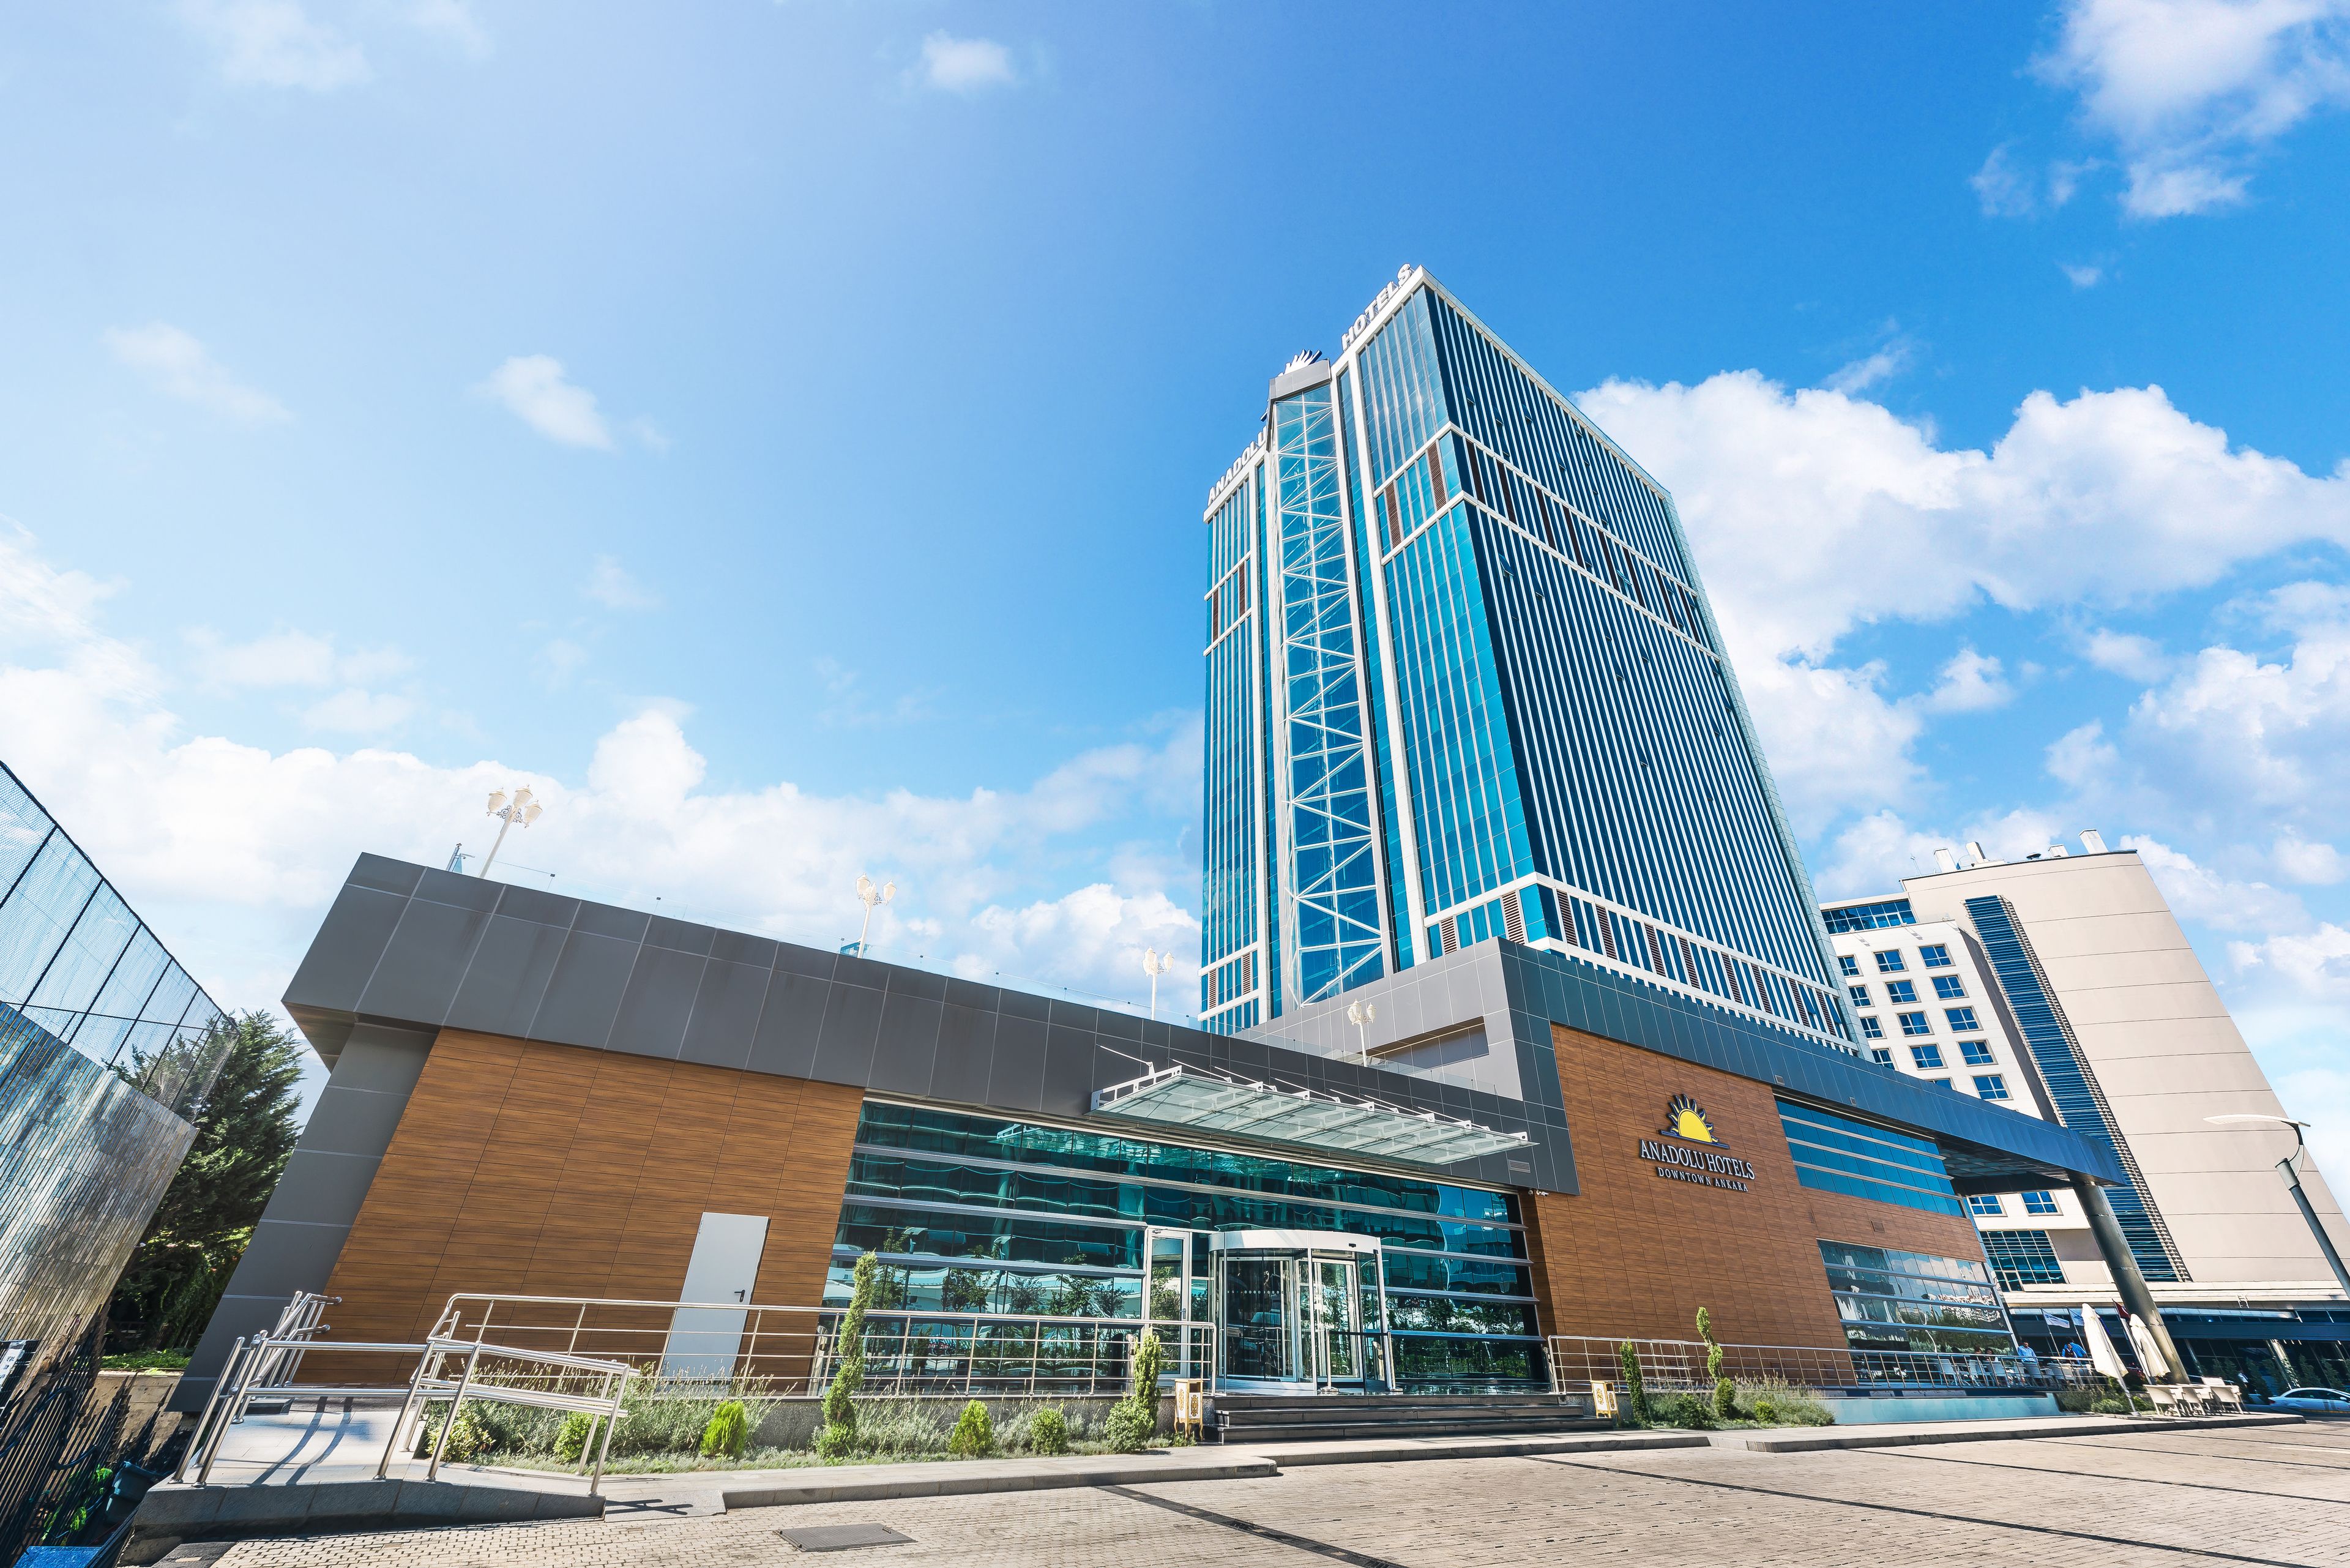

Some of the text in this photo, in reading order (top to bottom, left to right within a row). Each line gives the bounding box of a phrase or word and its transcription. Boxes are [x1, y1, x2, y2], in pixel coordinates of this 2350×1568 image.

[1341, 263, 1412, 351] HOTELS
[1640, 1139, 1755, 1180] ANADOLU HOTELS
[1657, 1167, 1749, 1192] DOWNTOWN ANKARA
